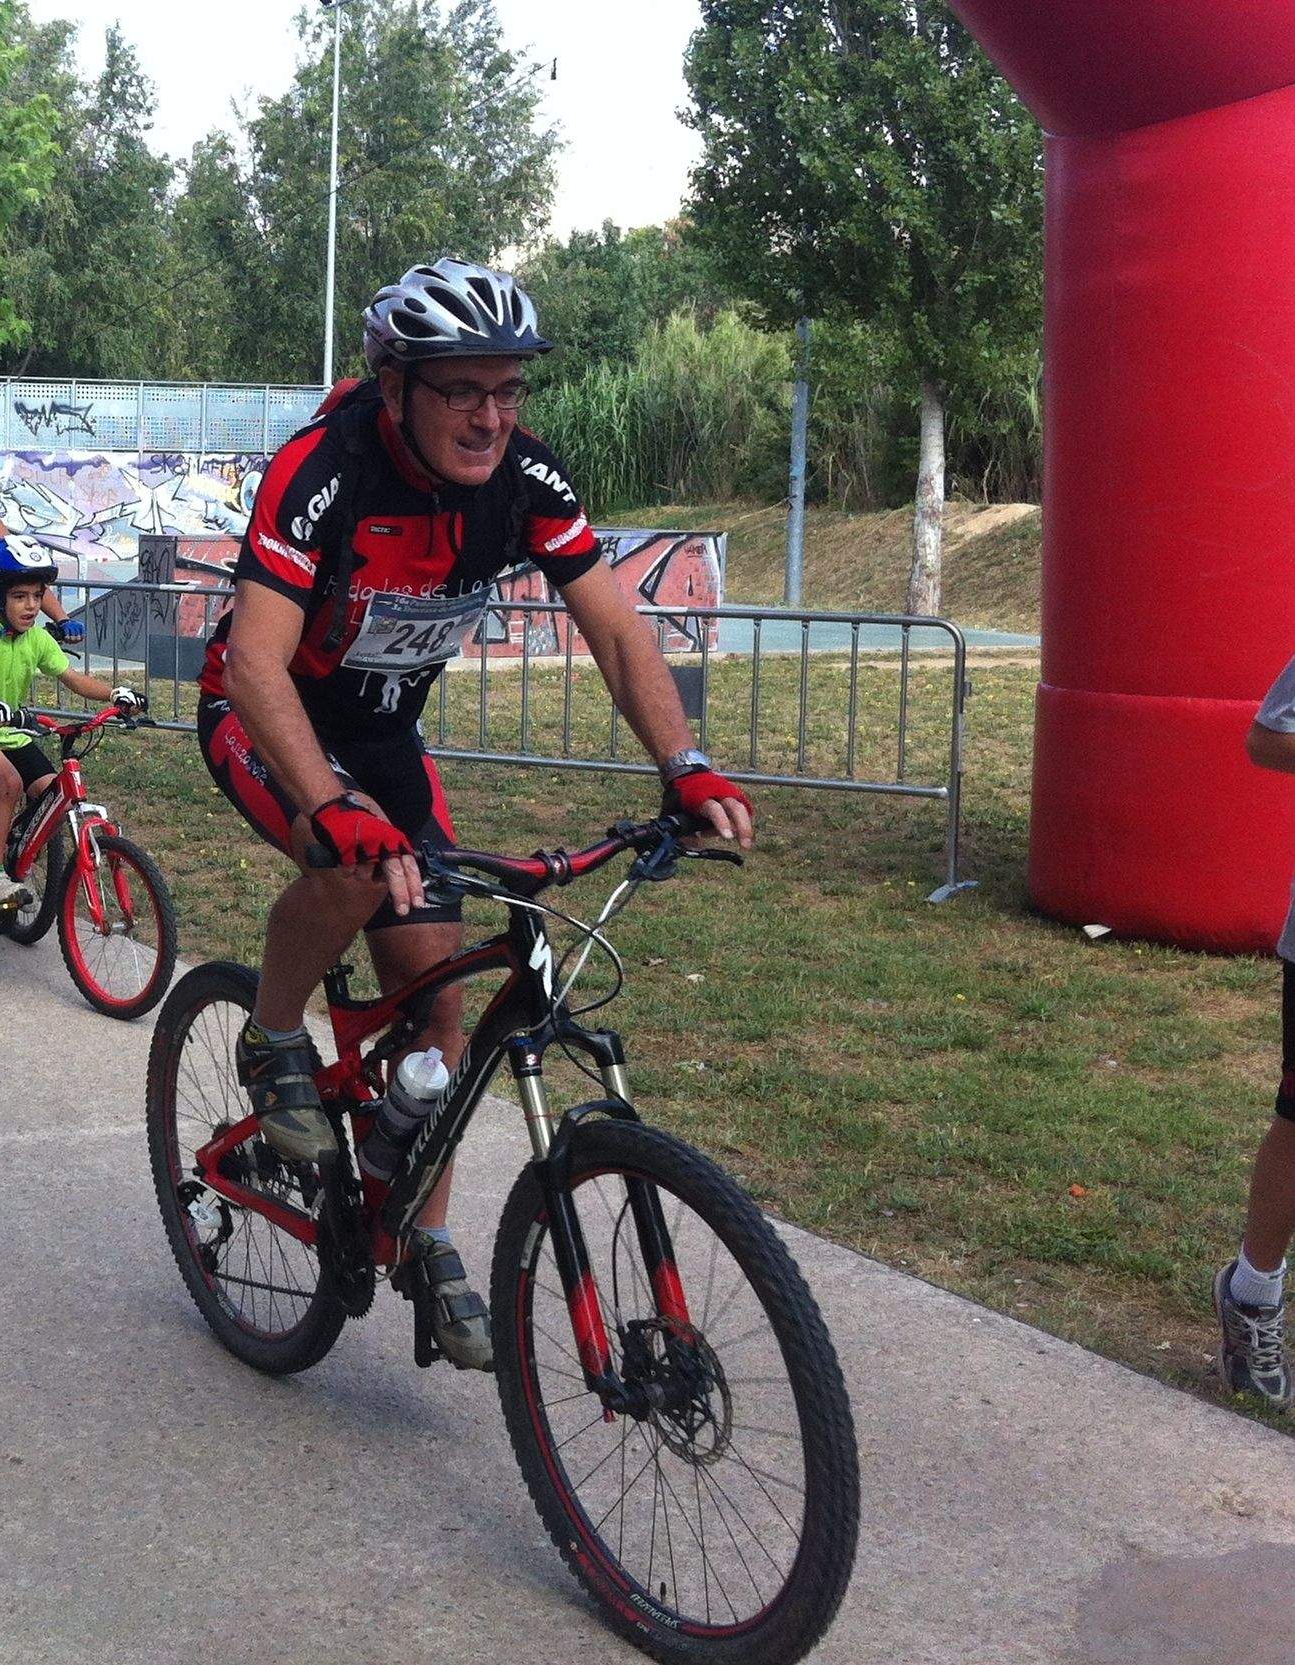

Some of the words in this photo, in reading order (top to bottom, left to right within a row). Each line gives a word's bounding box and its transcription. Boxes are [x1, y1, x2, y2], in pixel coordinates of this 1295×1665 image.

[308, 476, 340, 522] GIA
[518, 456, 577, 503] IANT
[382, 620, 456, 657] 248
